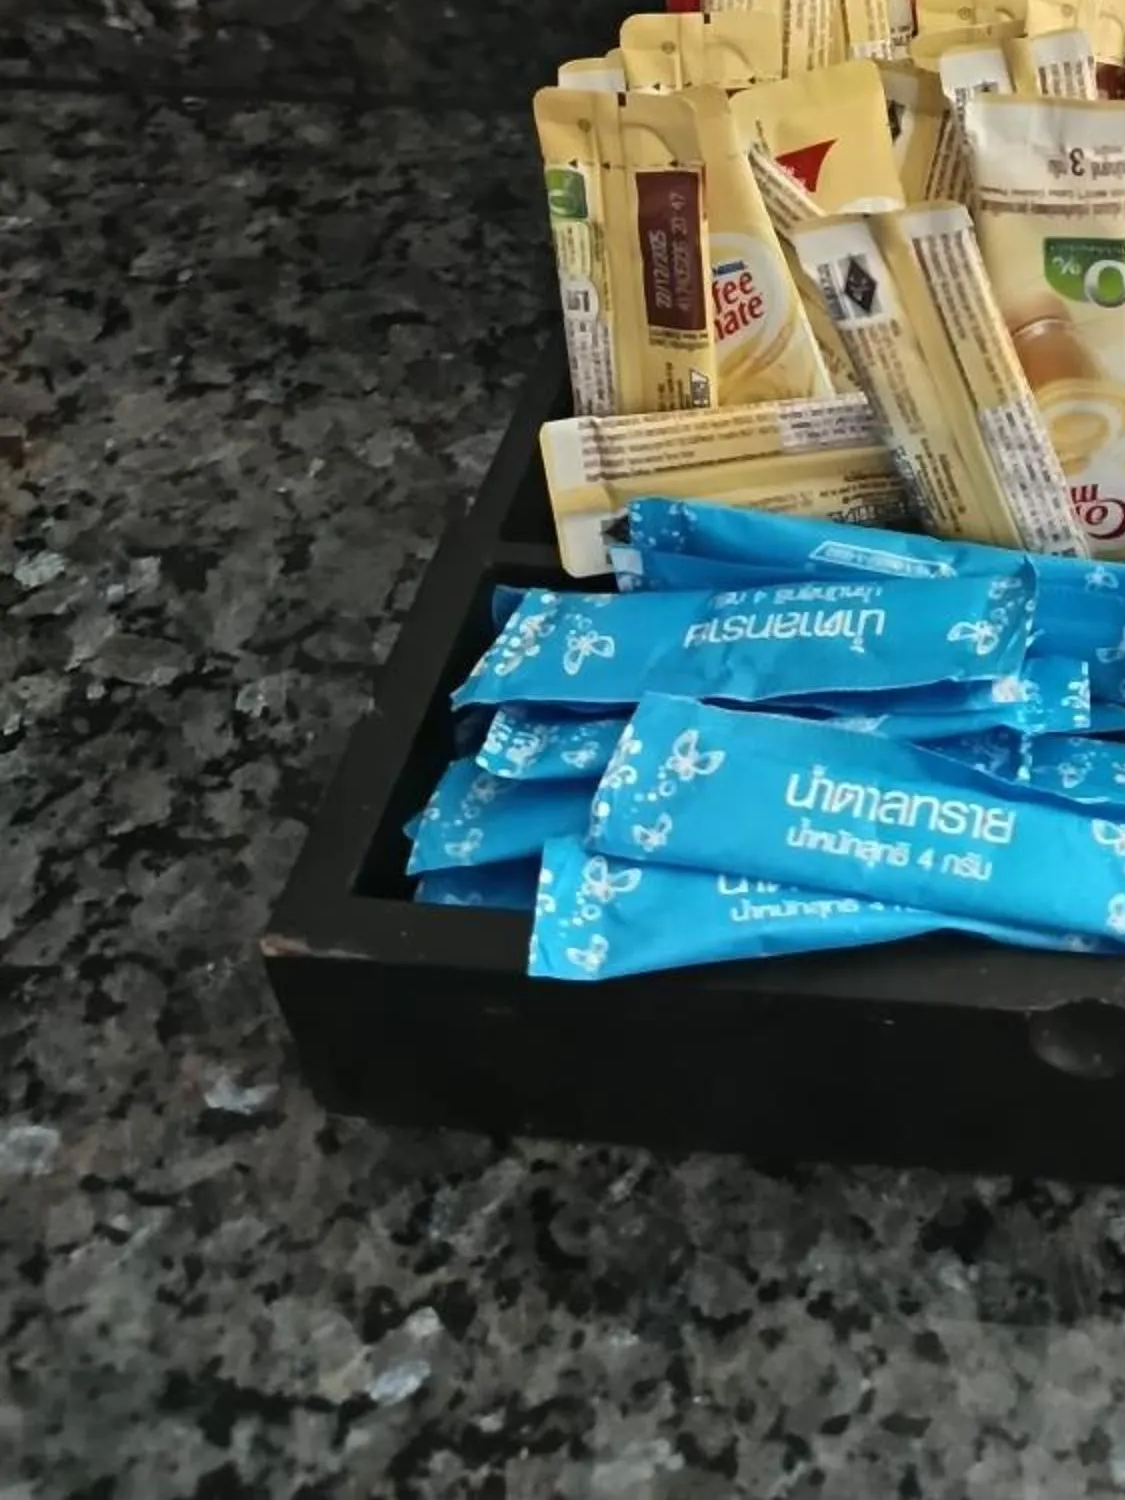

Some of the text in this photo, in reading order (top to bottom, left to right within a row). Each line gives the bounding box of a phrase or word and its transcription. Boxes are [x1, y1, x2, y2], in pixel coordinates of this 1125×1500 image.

[1069, 148, 1085, 176] 3
[683, 609, 885, 653] น้ำตาลทราย
[786, 764, 1016, 844] น้ำตาลทราย
[786, 817, 993, 881] น้ำหนักสุทธิ 4 กรัม
